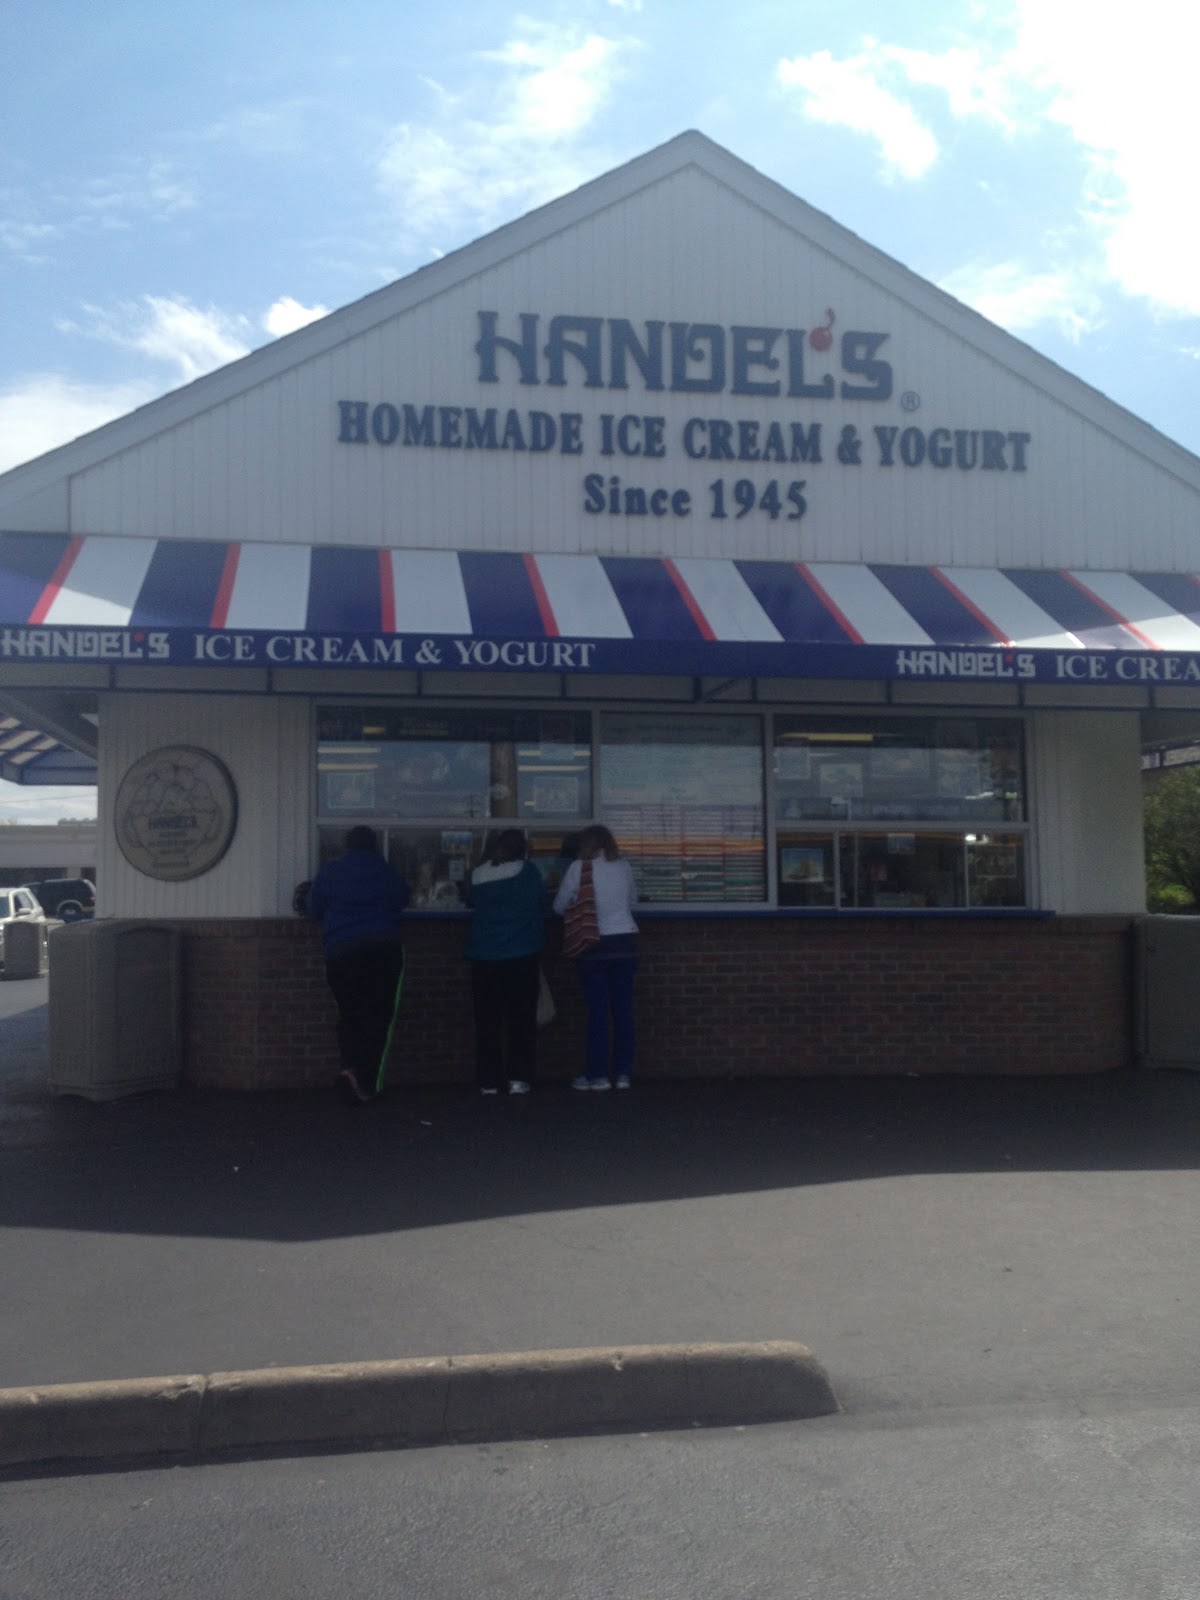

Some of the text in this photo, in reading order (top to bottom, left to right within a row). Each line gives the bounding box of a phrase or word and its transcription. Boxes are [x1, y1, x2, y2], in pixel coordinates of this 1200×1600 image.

[475, 309, 893, 401] HANDEL'S
[338, 400, 1030, 472] HOMEMADE ICE CREAM & YOGURT
[583, 473, 808, 520] Since 1945
[2, 630, 596, 668] HANDEL'S ICE CREAM & YOGURT
[896, 650, 1036, 678] HANDEL'S
[1056, 654, 1108, 679] ICE
